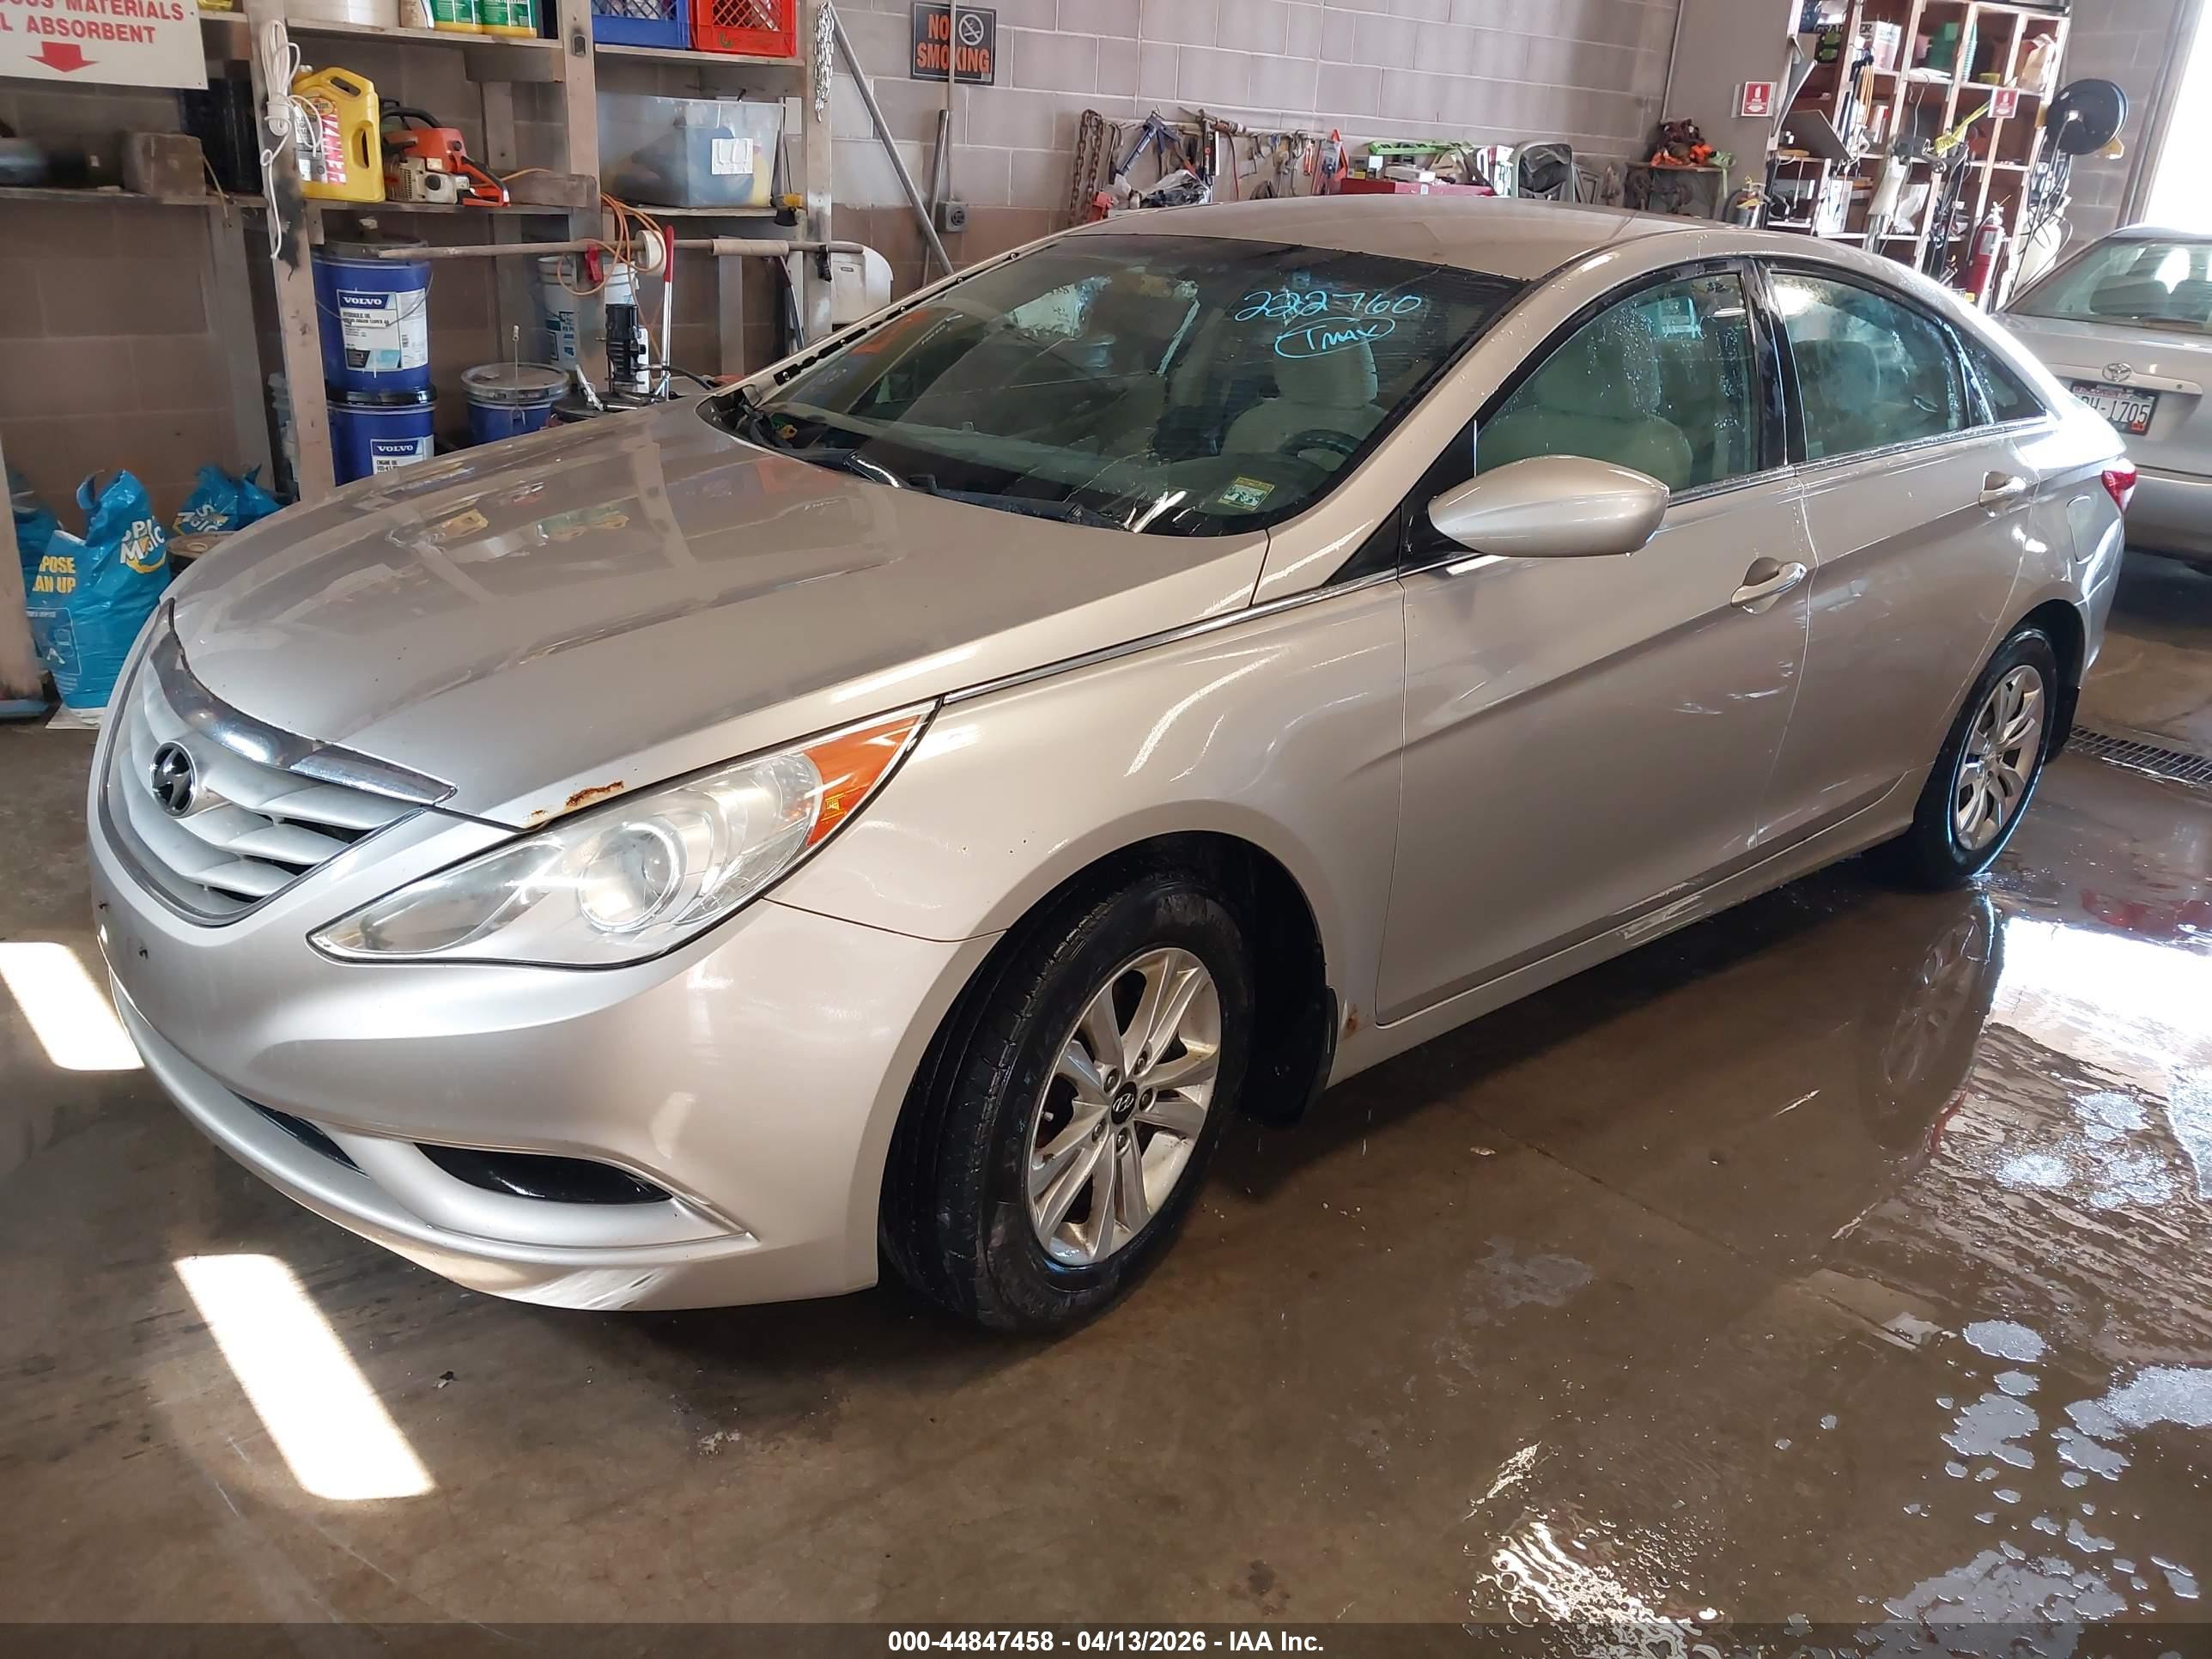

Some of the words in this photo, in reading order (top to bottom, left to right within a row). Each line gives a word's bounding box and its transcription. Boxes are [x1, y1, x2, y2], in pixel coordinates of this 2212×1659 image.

[66, 0, 185, 21] MATERIALS
[27, 15, 155, 43] ABSORBENT
[928, 14, 950, 40] NO
[916, 41, 990, 73] SMOKING
[343, 296, 383, 306] VOLVO
[57, 576, 76, 593] UP
